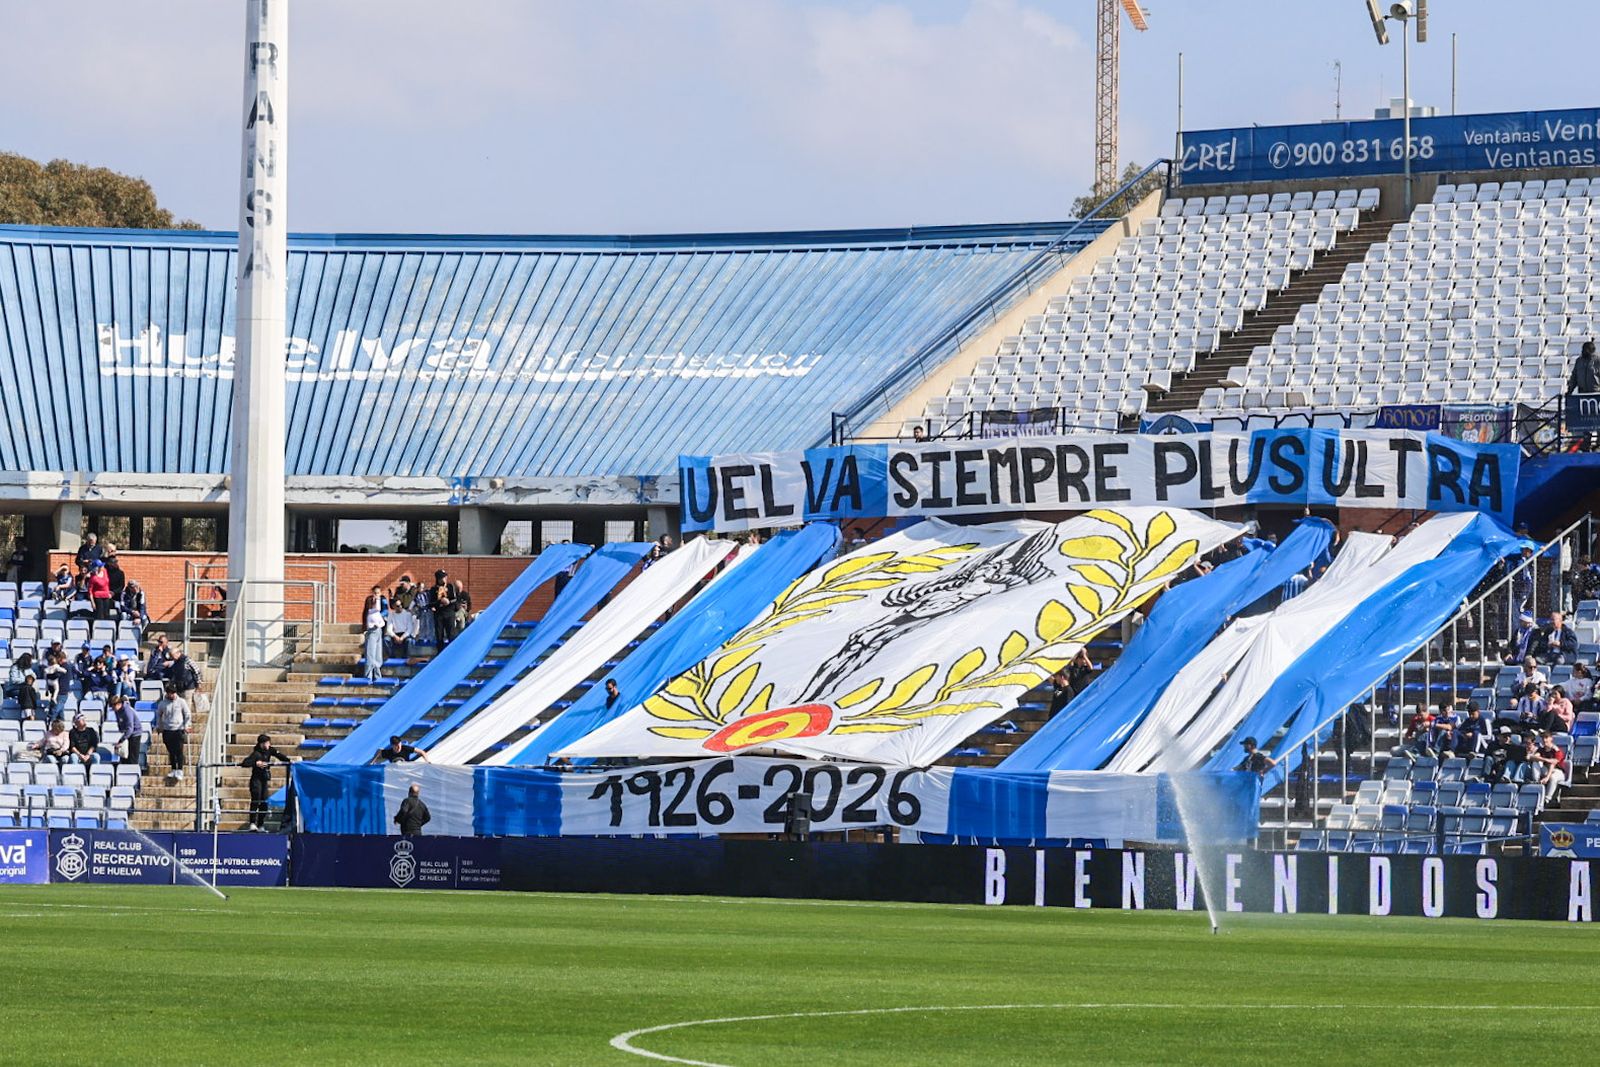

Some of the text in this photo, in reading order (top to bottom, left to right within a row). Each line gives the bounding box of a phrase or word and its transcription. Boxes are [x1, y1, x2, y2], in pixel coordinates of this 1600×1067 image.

[1464, 130, 1540, 145] Ventanas
[1181, 137, 1237, 171] CRE!
[1294, 142, 1336, 166] 900
[1341, 138, 1380, 163] 831
[1485, 147, 1596, 168] Ventanas
[889, 443, 1131, 509] SIEMPRE
[1154, 436, 1305, 501] PLUS
[1322, 439, 1499, 511] ULTRA
[588, 759, 931, 827] 1926-2026
[94, 841, 142, 851] REAL CLUB
[93, 855, 170, 866] RECREATIVO
[93, 867, 142, 876] DE HUELVA
[985, 848, 1592, 922] BIENVENIDOS A
